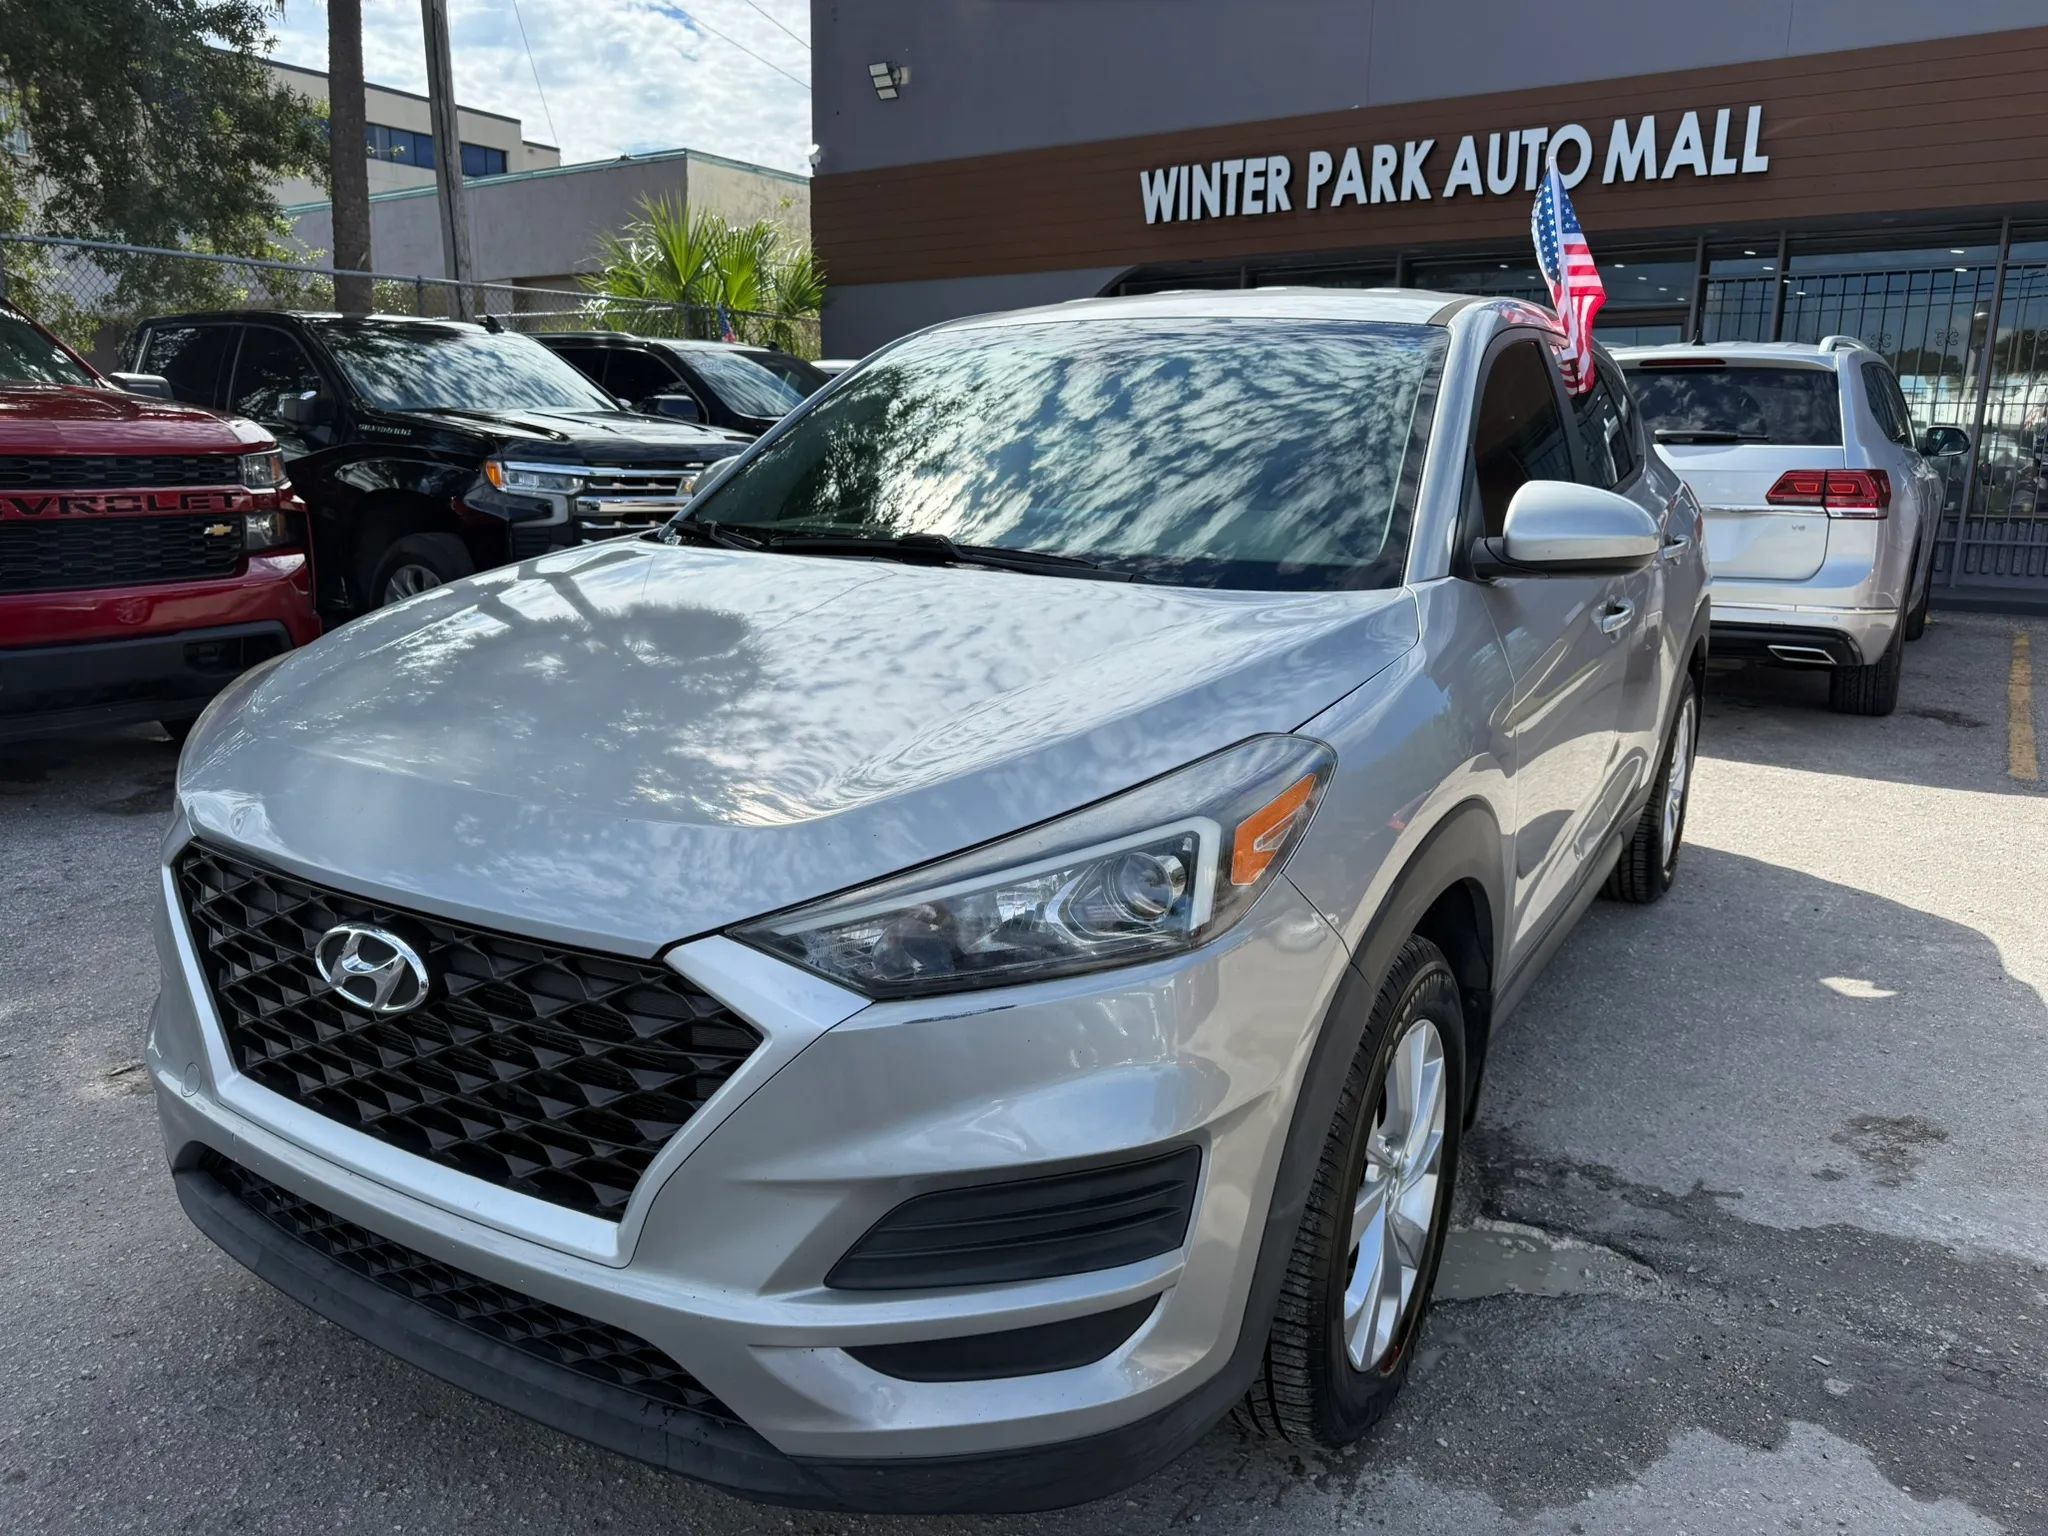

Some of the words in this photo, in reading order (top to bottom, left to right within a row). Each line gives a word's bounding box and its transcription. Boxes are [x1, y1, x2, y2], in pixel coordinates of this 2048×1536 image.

[1140, 155, 1293, 225] WINTER
[1306, 139, 1436, 209] PARK
[1442, 123, 1593, 198] AUTO
[1602, 105, 1769, 184] MALL
[0, 494, 242, 518] VROLET
